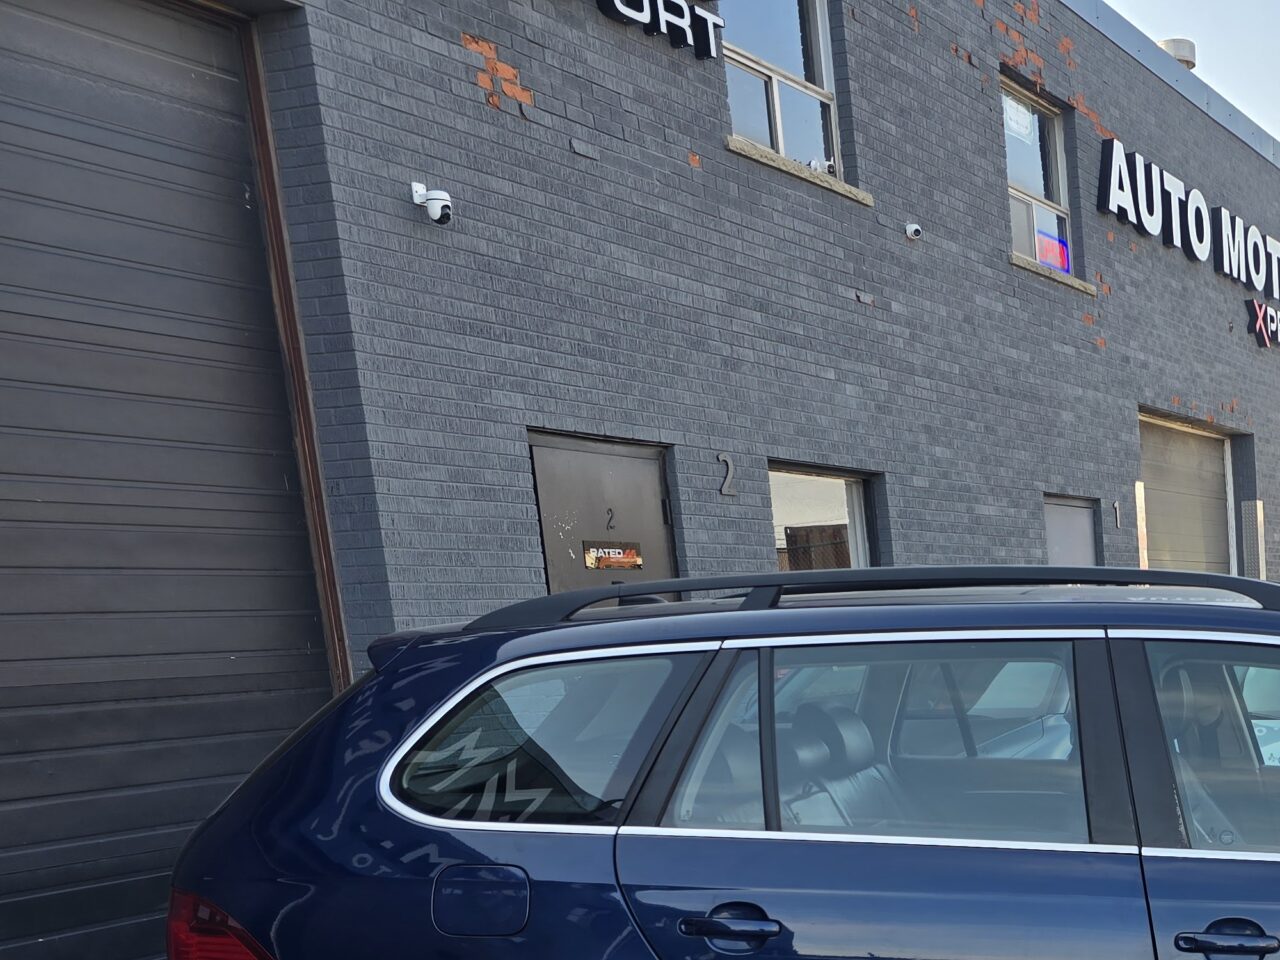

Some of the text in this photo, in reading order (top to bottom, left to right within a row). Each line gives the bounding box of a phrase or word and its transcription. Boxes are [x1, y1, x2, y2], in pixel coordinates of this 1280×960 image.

[1107, 138, 1211, 262] AUTO
[717, 452, 737, 496] 2
[606, 508, 616, 531] 2
[1112, 500, 1122, 529] 1
[590, 547, 623, 557] RATED
